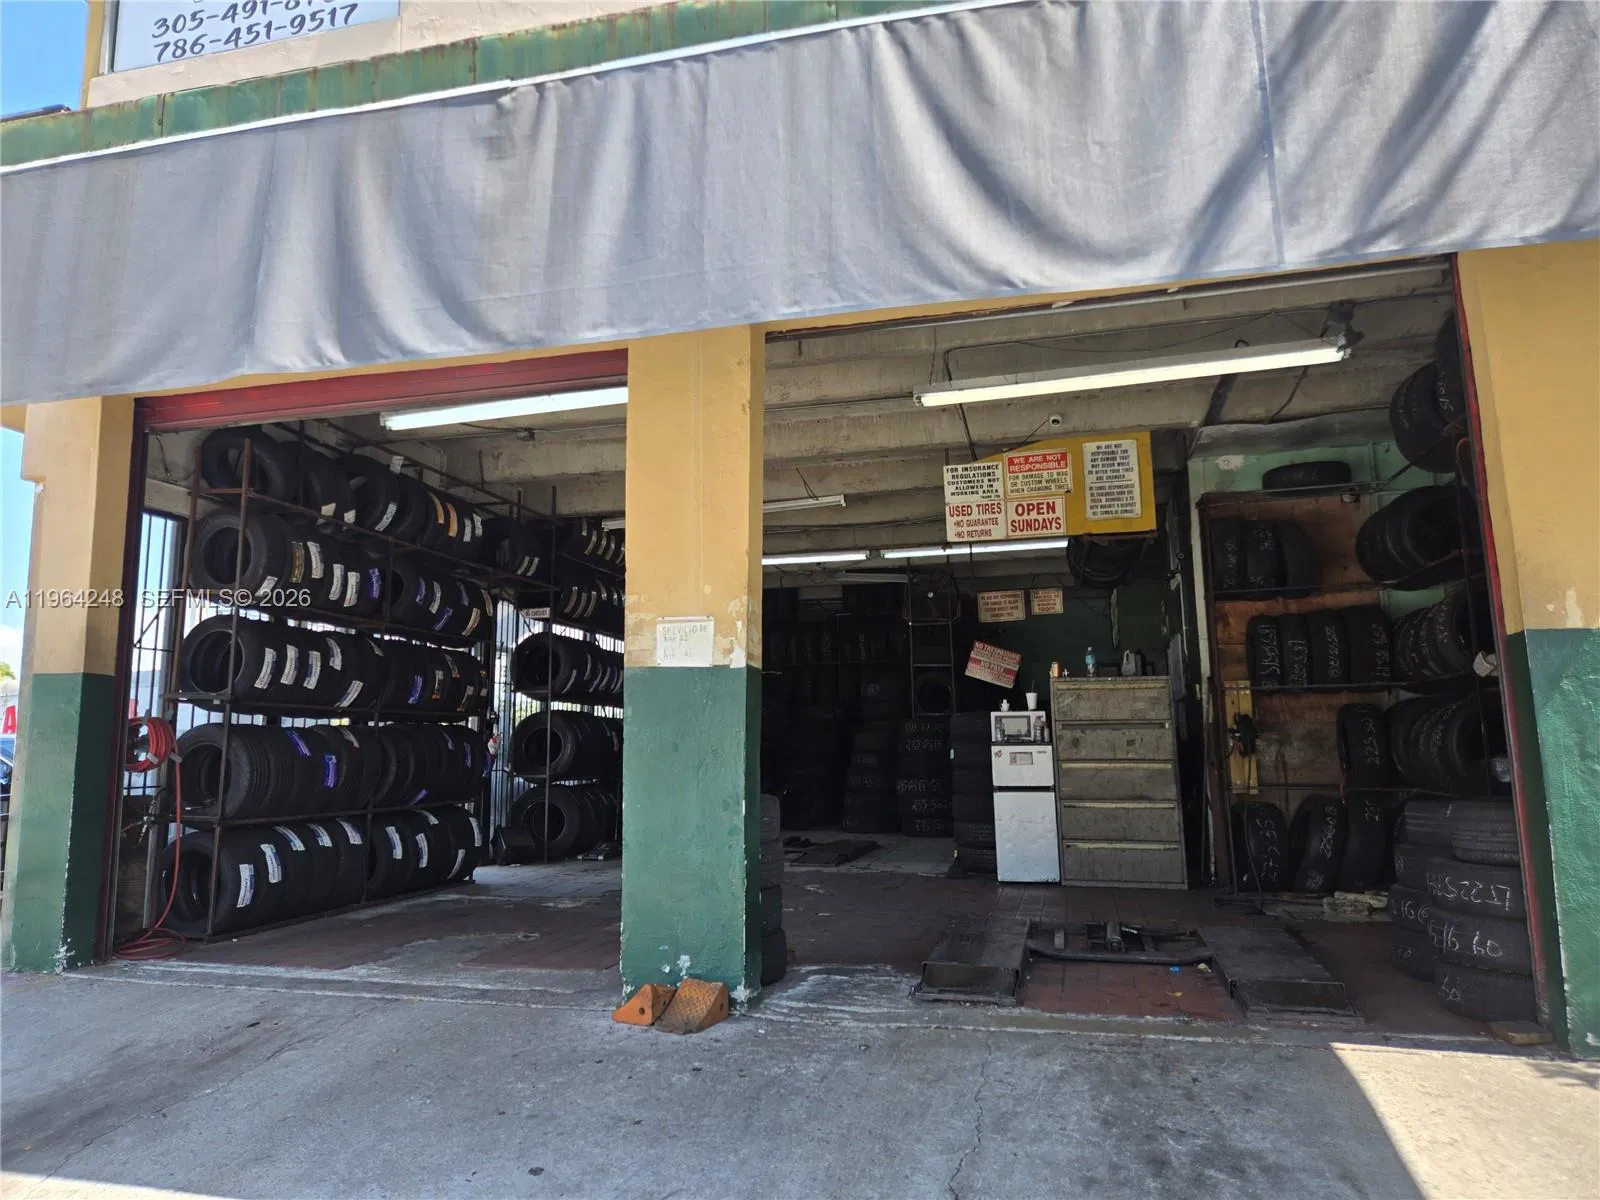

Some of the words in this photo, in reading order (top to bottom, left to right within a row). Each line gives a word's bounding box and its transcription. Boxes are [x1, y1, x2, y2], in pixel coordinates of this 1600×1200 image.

[153, 3, 358, 62] 786-451-9517
[961, 464, 999, 472] INSURANCE
[1009, 460, 1067, 473] RESPONSIBLE
[951, 471, 996, 480] REGULATIONS
[1022, 472, 1044, 480] DAMAGE
[1020, 479, 1043, 487] CUSTOM
[1045, 477, 1068, 485] WHEELS
[949, 504, 973, 517] USED
[976, 502, 1002, 516] TIRES
[1015, 501, 1056, 517] OPEN
[965, 517, 999, 527] GUARANTEE
[1010, 516, 1062, 533] SUNDAYS
[966, 528, 992, 538] RETURNS
